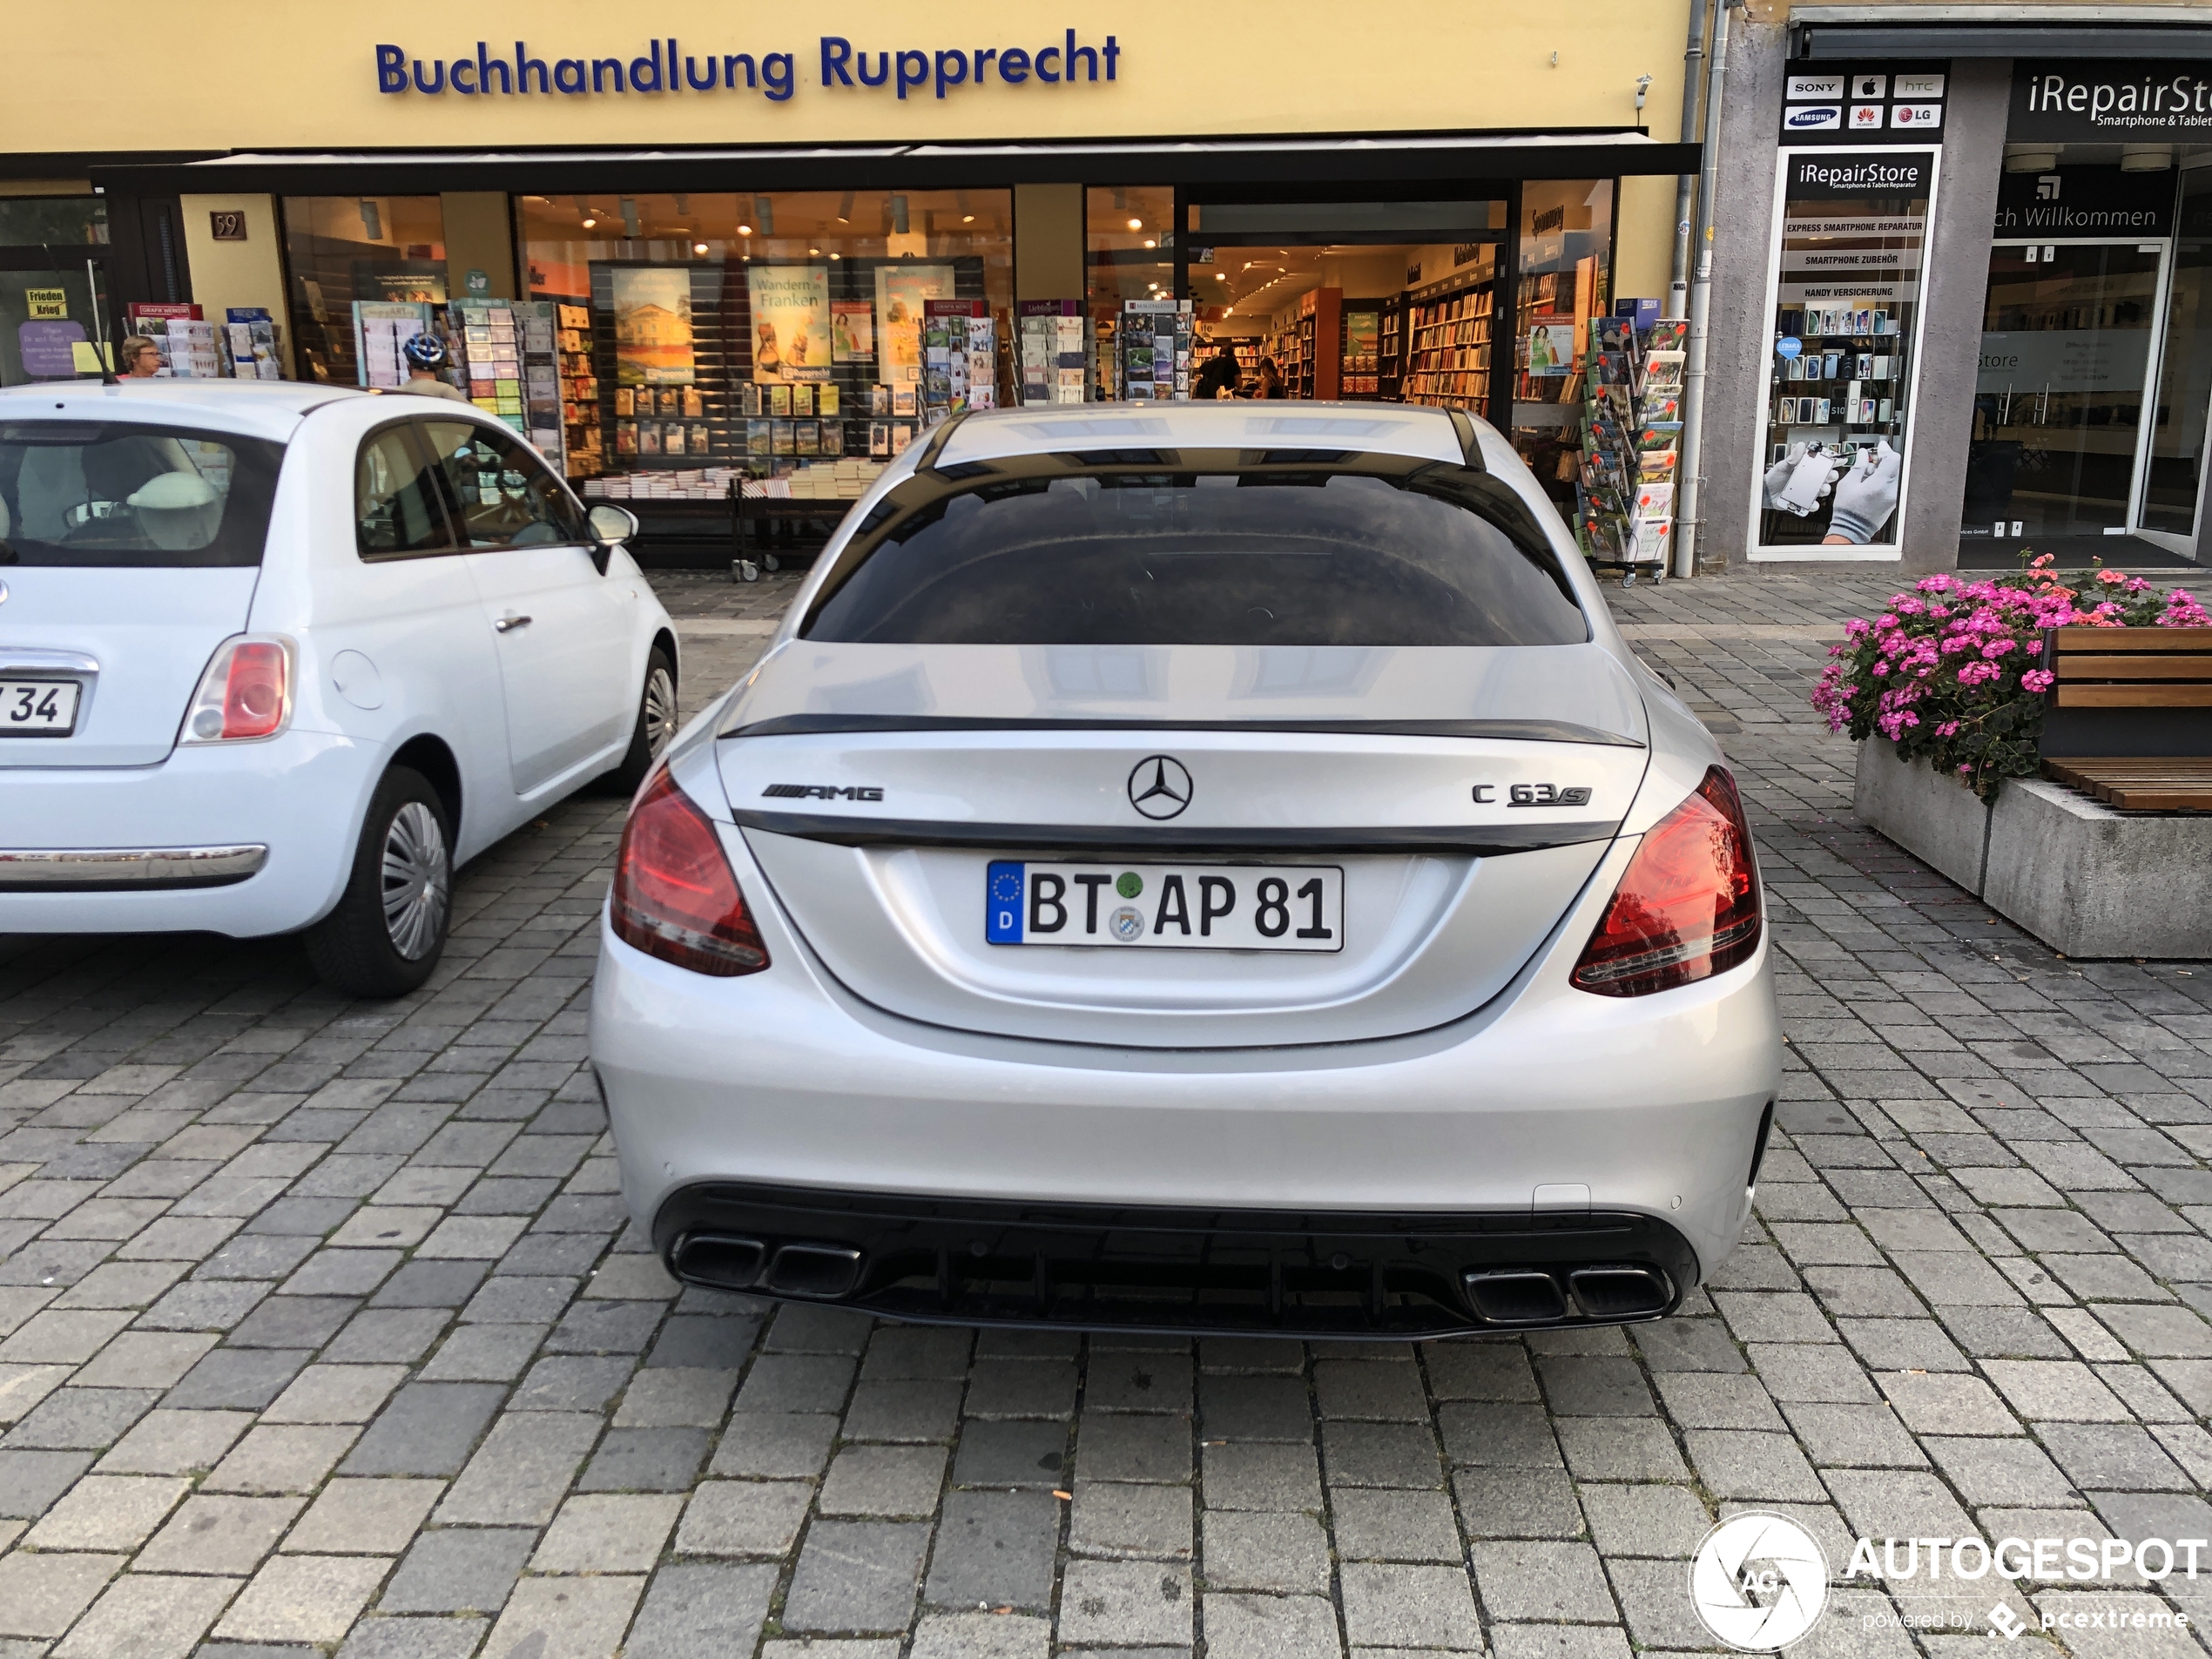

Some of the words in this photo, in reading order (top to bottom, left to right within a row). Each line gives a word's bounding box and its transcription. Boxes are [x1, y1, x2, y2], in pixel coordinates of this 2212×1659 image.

[374, 38, 795, 101] Buchhandlung
[819, 28, 1121, 100] Rupprecht
[1795, 83, 1836, 92] SONY
[1795, 113, 1831, 122] SAMSUNG
[1915, 110, 1931, 120] LG
[2097, 114, 2166, 128] Smartphone
[2168, 115, 2176, 126] &
[1800, 163, 1919, 186] iRepairStore
[1994, 206, 2017, 227] ch
[2025, 206, 2156, 226] Willkommen
[217, 214, 237, 234] 59
[1787, 223, 1822, 233] EXPRESS
[1824, 222, 1877, 232] SMARTPHONE
[1878, 222, 1923, 231] REPARATUR
[1805, 255, 1860, 265] SMARTPHONE
[1861, 253, 1898, 264] ZUBEHÖR
[757, 279, 812, 290] Wandern
[29, 291, 63, 301] Frieden
[1804, 288, 1832, 297] HANDY
[1833, 287, 1893, 297] VERSICHERUNG
[760, 293, 819, 307] Franken
[36, 305, 60, 315] Krieg
[1978, 353, 2019, 368] Store
[1831, 406, 1845, 415] S10
[10, 687, 59, 722] 34
[788, 785, 885, 801] AMG
[1472, 784, 1496, 803] C
[1029, 873, 1112, 934] BT
[1153, 874, 1237, 936] AP
[1255, 876, 1332, 940] 81
[999, 911, 1013, 929] D
